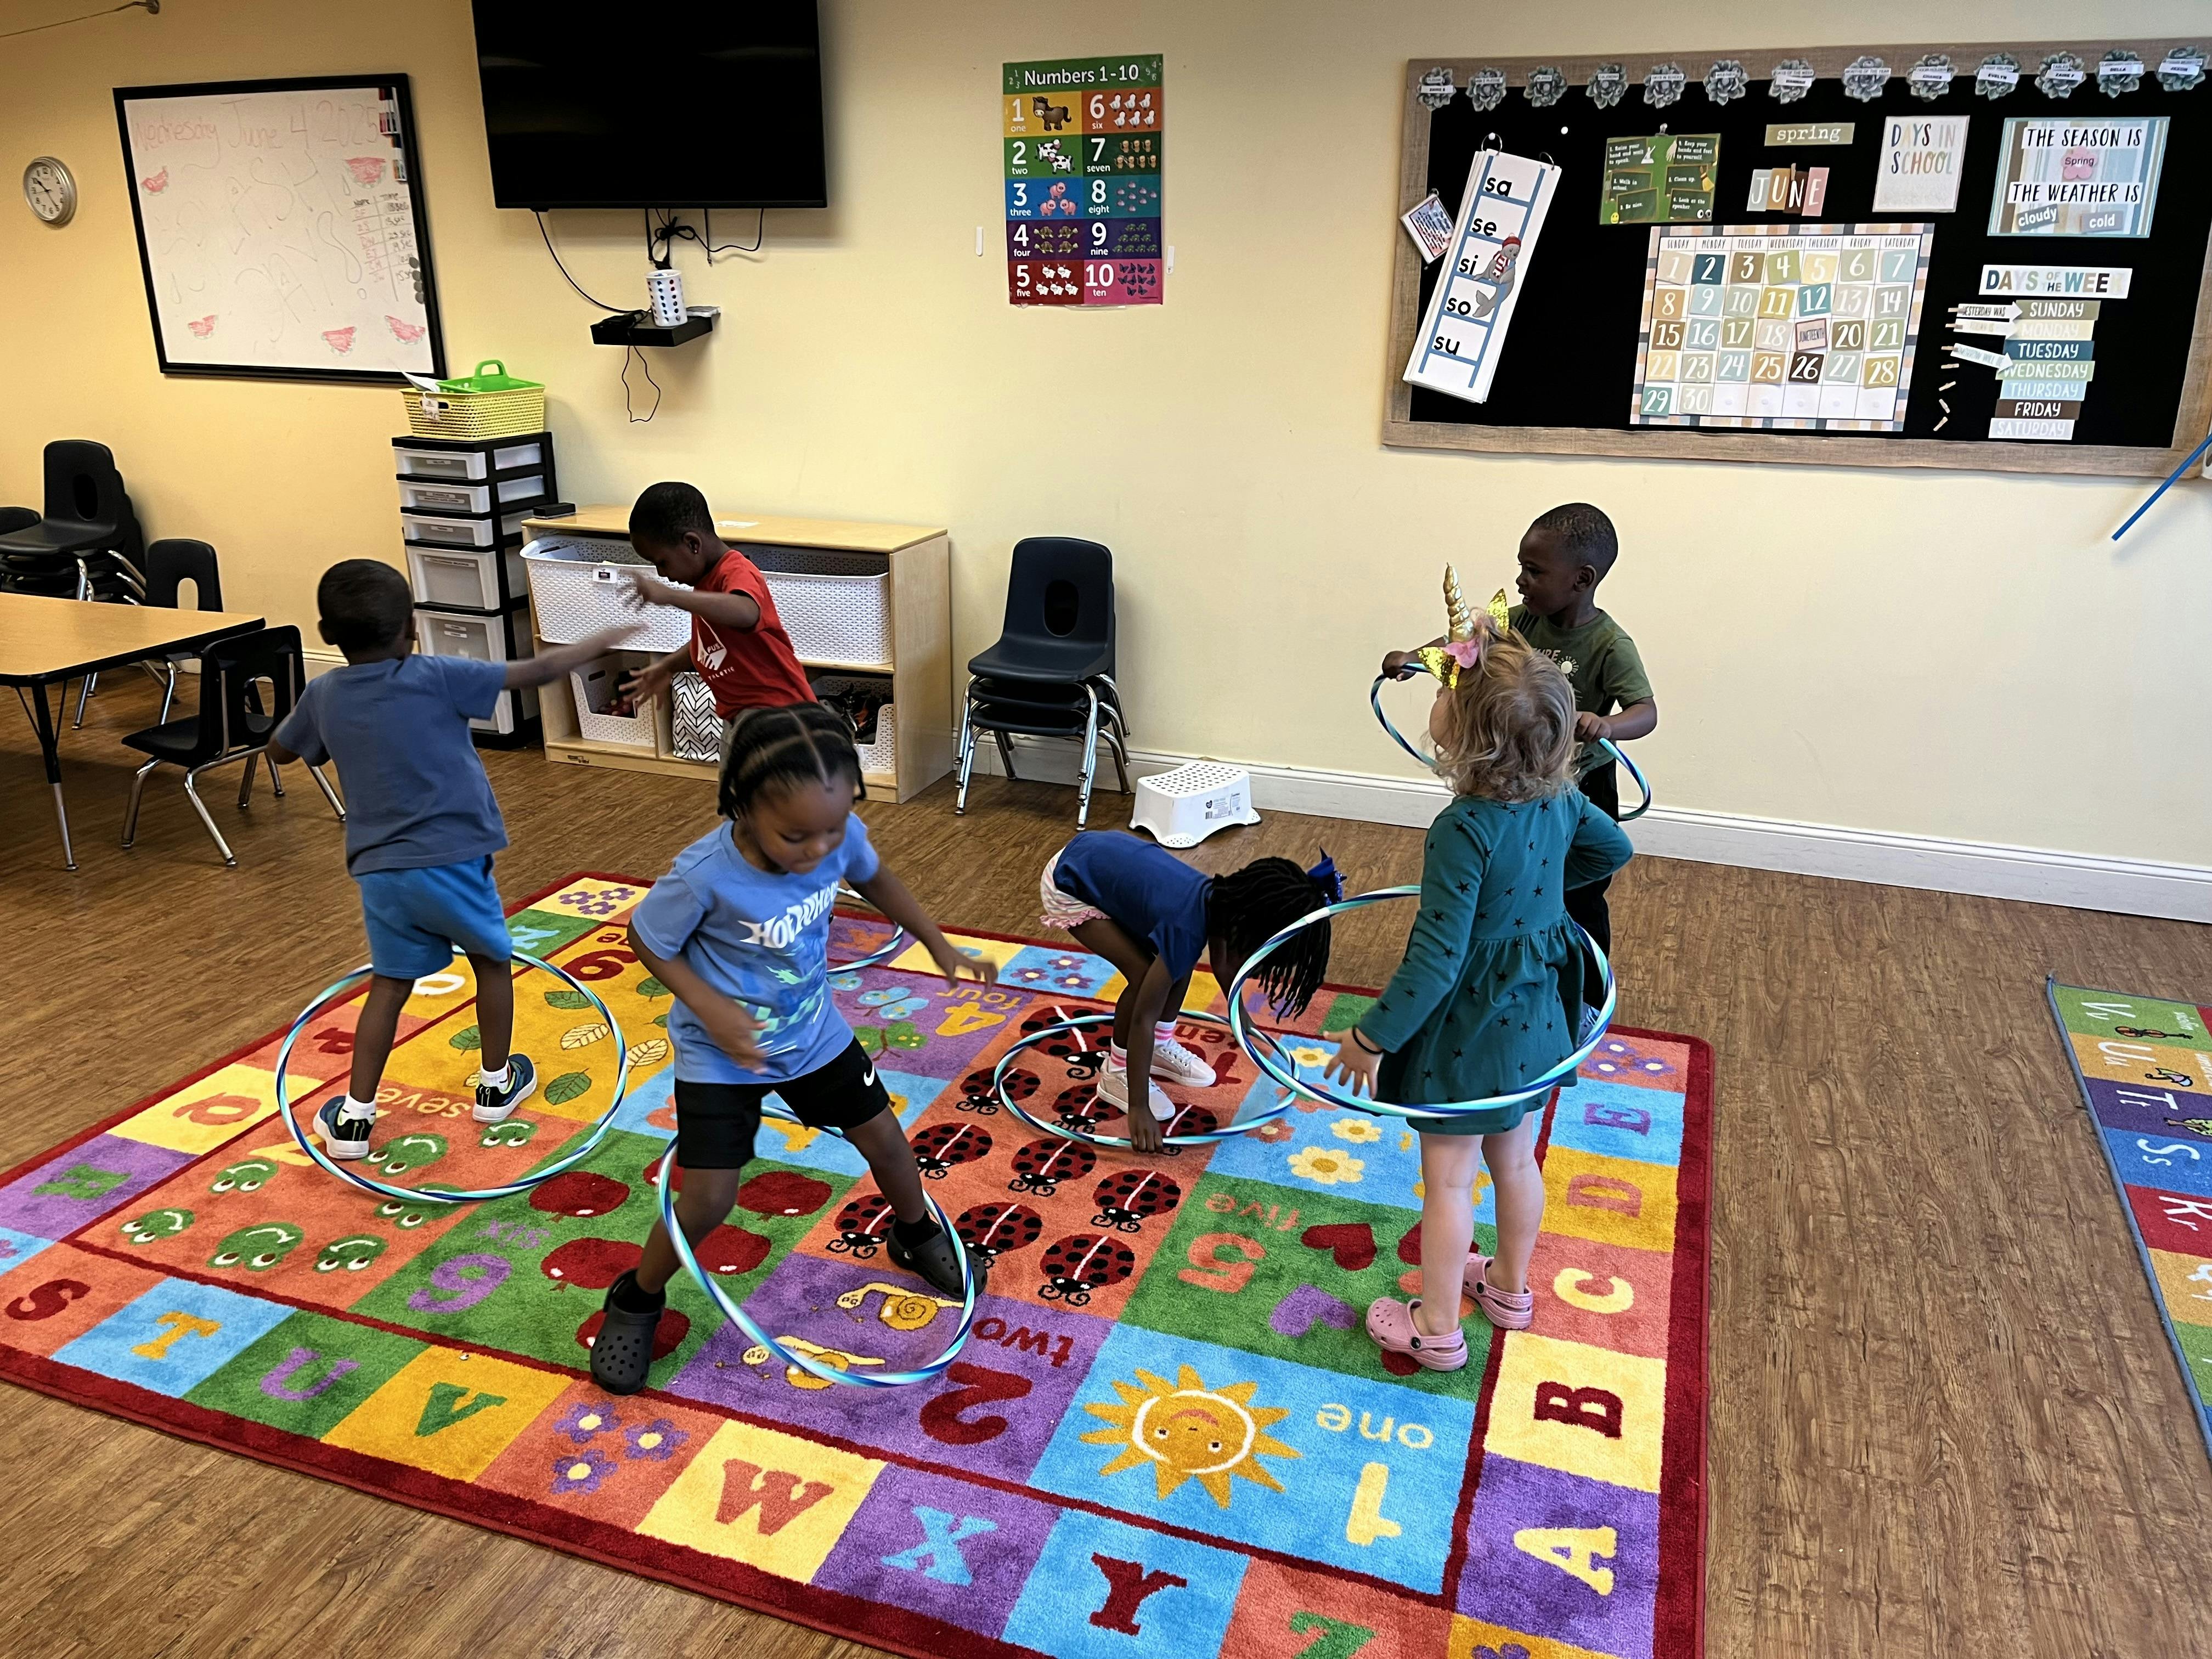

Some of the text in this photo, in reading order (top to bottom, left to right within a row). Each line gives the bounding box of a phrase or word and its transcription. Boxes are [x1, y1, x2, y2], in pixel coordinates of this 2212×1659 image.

[1024, 64, 1139, 85] Numbers 1-10
[1012, 98, 1024, 122] 1
[1090, 94, 1105, 119] 6
[221, 98, 283, 149] June
[316, 100, 377, 147] 2025
[1092, 121, 1103, 129] six
[1777, 126, 1841, 144] spring
[1891, 123, 1956, 148] DAYS IN
[2028, 128, 2142, 147] THE SEASON IS
[1012, 141, 1026, 165] 2
[1091, 138, 1105, 161] 7
[1891, 151, 1953, 175] SCHOOL
[2065, 157, 2094, 166] Spring
[1013, 183, 1027, 206] 3
[1092, 179, 1106, 203] 8
[1485, 177, 1512, 197] sa
[1752, 176, 1821, 208] JUNE
[2012, 184, 2140, 202] THE WEATHER IS
[1088, 205, 1109, 215] eight
[2018, 207, 2057, 227] cloudy
[2089, 215, 2115, 228] cold
[1014, 224, 1029, 246] 4
[1092, 222, 1107, 246] 9
[1472, 218, 1497, 236] se
[1014, 249, 1030, 257] four
[1091, 247, 1108, 256] nine
[1667, 239, 1689, 249] SUNDAY
[1702, 239, 1726, 249] MONDAY
[1737, 239, 1763, 249] TUESDAY
[1770, 239, 1804, 249] WEDNESDAY
[1809, 238, 1839, 247] THURSDAY
[1850, 238, 1872, 247] FRIDAY
[1884, 238, 1916, 247] SATURDAY
[1017, 264, 1030, 287] 5
[1085, 263, 1114, 287] 10
[1459, 255, 1478, 275] si
[1667, 256, 1680, 279] 1
[1701, 257, 1716, 280] 2
[1741, 256, 1754, 279] 3
[1777, 256, 1791, 278] 4
[1812, 258, 1826, 281] 5
[1849, 253, 1865, 276] 6
[1892, 253, 1906, 278] 7
[1986, 270, 2039, 291] DAYS
[2046, 272, 2061, 282] OF
[1447, 298, 1471, 315] so
[1662, 292, 1676, 316] 8
[1701, 288, 1714, 312] 9
[1729, 291, 1753, 313] 10
[1764, 291, 1787, 315] 11
[1803, 286, 1827, 313] 12
[1836, 289, 1861, 313] 13
[1880, 290, 1904, 313] 14
[2030, 303, 2084, 317] SUNDAY
[1962, 306, 2006, 317] YESTERDAY WAS
[1656, 324, 1680, 347] 15
[1690, 323, 1716, 345] 16
[1726, 321, 1750, 344] 17
[1762, 324, 1786, 347] 18
[1799, 328, 1825, 343] JUNETEENTH
[1835, 324, 1861, 347] 20
[1874, 322, 1899, 346] 21
[2021, 323, 2080, 338] MONDAY
[1434, 336, 1460, 356] su
[2018, 343, 2079, 359] TUESDAY
[1650, 354, 1673, 377] 22
[1685, 357, 1709, 379] 23
[1719, 355, 1745, 377] 24
[1755, 356, 1782, 380] 25
[1791, 356, 1819, 380] 26
[1829, 354, 1856, 378] 27
[1868, 360, 1894, 385] 28
[2002, 364, 2088, 378] WEDNESDAY
[1643, 390, 1669, 413] 29
[1683, 388, 1708, 411] 30
[2010, 383, 2078, 398] THURSDAY
[2015, 402, 2061, 416] FRIDAY
[1997, 421, 2066, 436] SATURDAY
[936, 987, 1023, 1010] four
[935, 1002, 1006, 1037] 4
[173, 1093, 261, 1126] Q
[376, 1085, 470, 1117] seve
[1584, 1102, 1652, 1136] E
[32, 1163, 132, 1200] R
[1566, 1174, 1644, 1218] D
[1204, 1193, 1300, 1233] five
[477, 1220, 549, 1249] six
[1177, 1232, 1267, 1293] 5
[6, 1279, 91, 1321] S
[1553, 1267, 1635, 1315] C
[131, 1311, 222, 1361] T
[972, 1317, 1075, 1368] two
[260, 1347, 360, 1401] U
[415, 1381, 507, 1437] V
[918, 1361, 1032, 1445] 2
[1533, 1381, 1622, 1440] B
[1317, 1403, 1434, 1449] one
[715, 1458, 834, 1536] W
[1346, 1462, 1402, 1545] 1
[880, 1505, 998, 1587] X
[1514, 1527, 1617, 1596] A
[1088, 1552, 1188, 1636] Y
